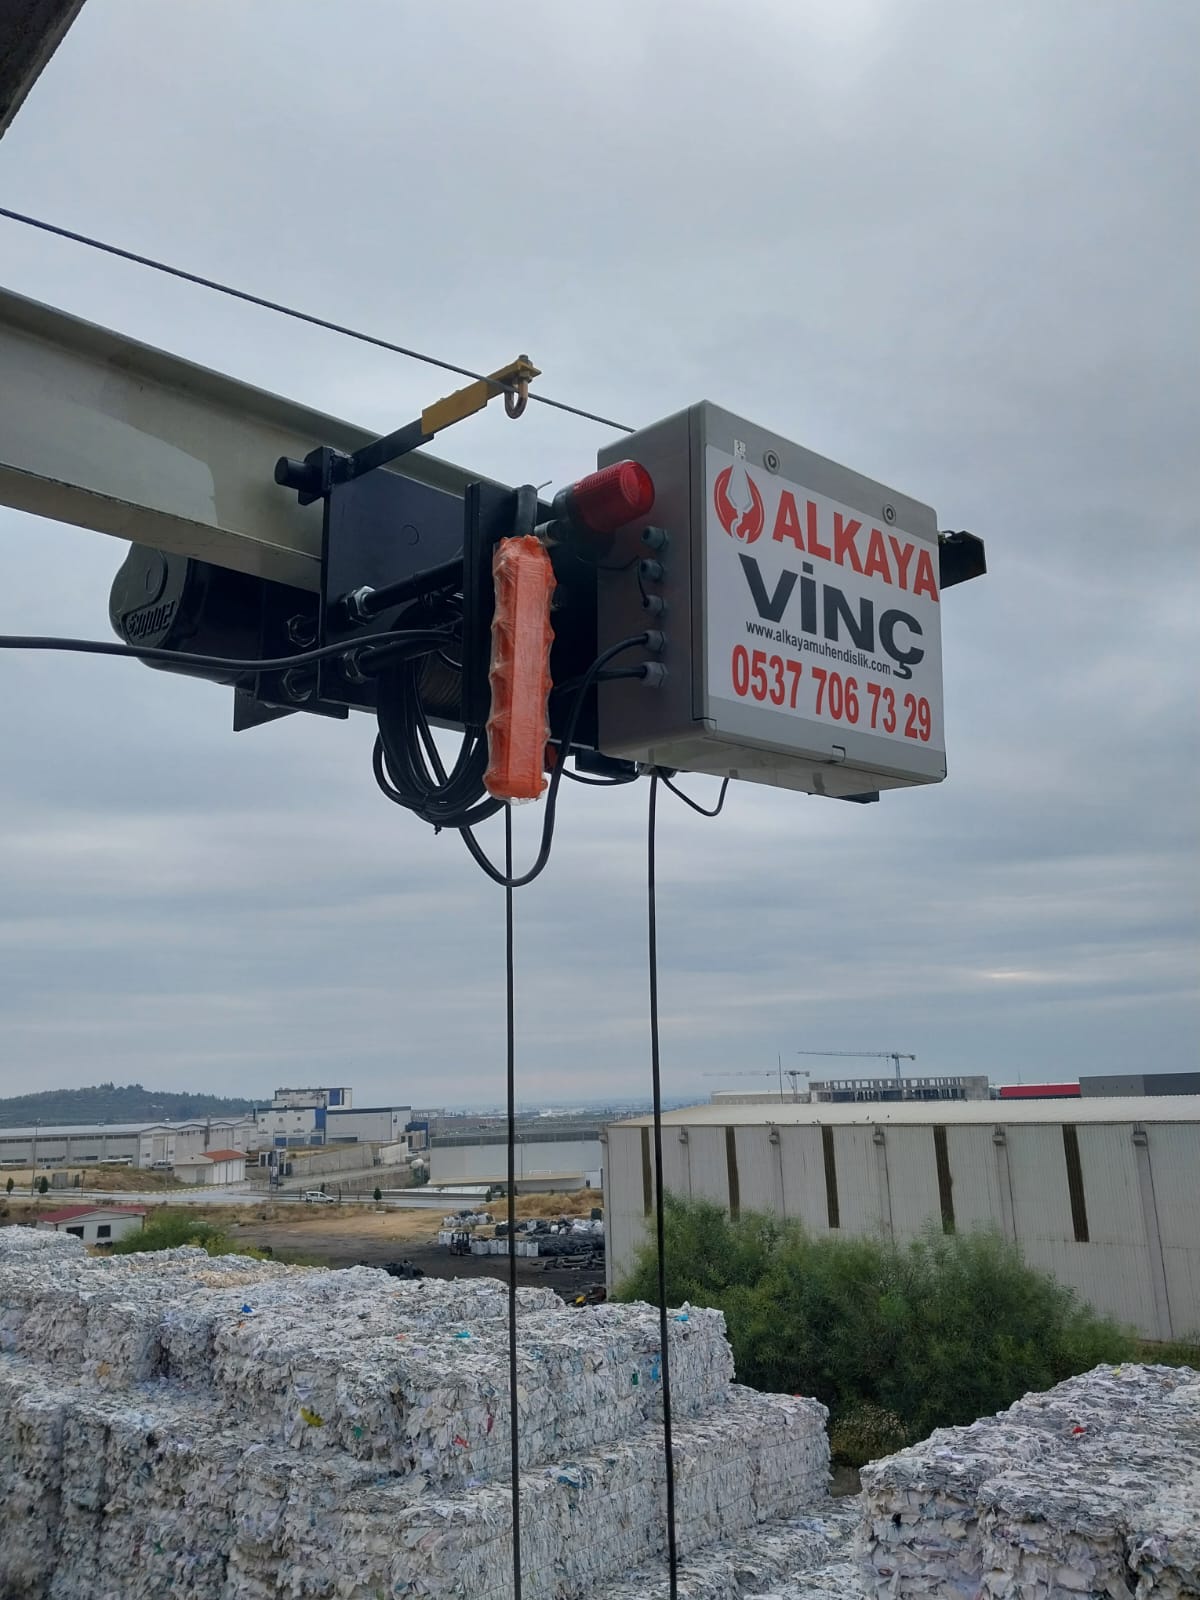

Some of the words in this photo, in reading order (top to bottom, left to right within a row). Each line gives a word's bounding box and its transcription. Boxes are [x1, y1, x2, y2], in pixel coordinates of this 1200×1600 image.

[772, 490, 939, 602] ALKAYA
[738, 552, 925, 680] VİNÇ
[745, 621, 891, 675] www.alkayamuhendislik.com
[731, 644, 802, 708] 0537
[811, 667, 859, 724] 706
[867, 682, 897, 733] 73
[904, 693, 931, 742] 29
